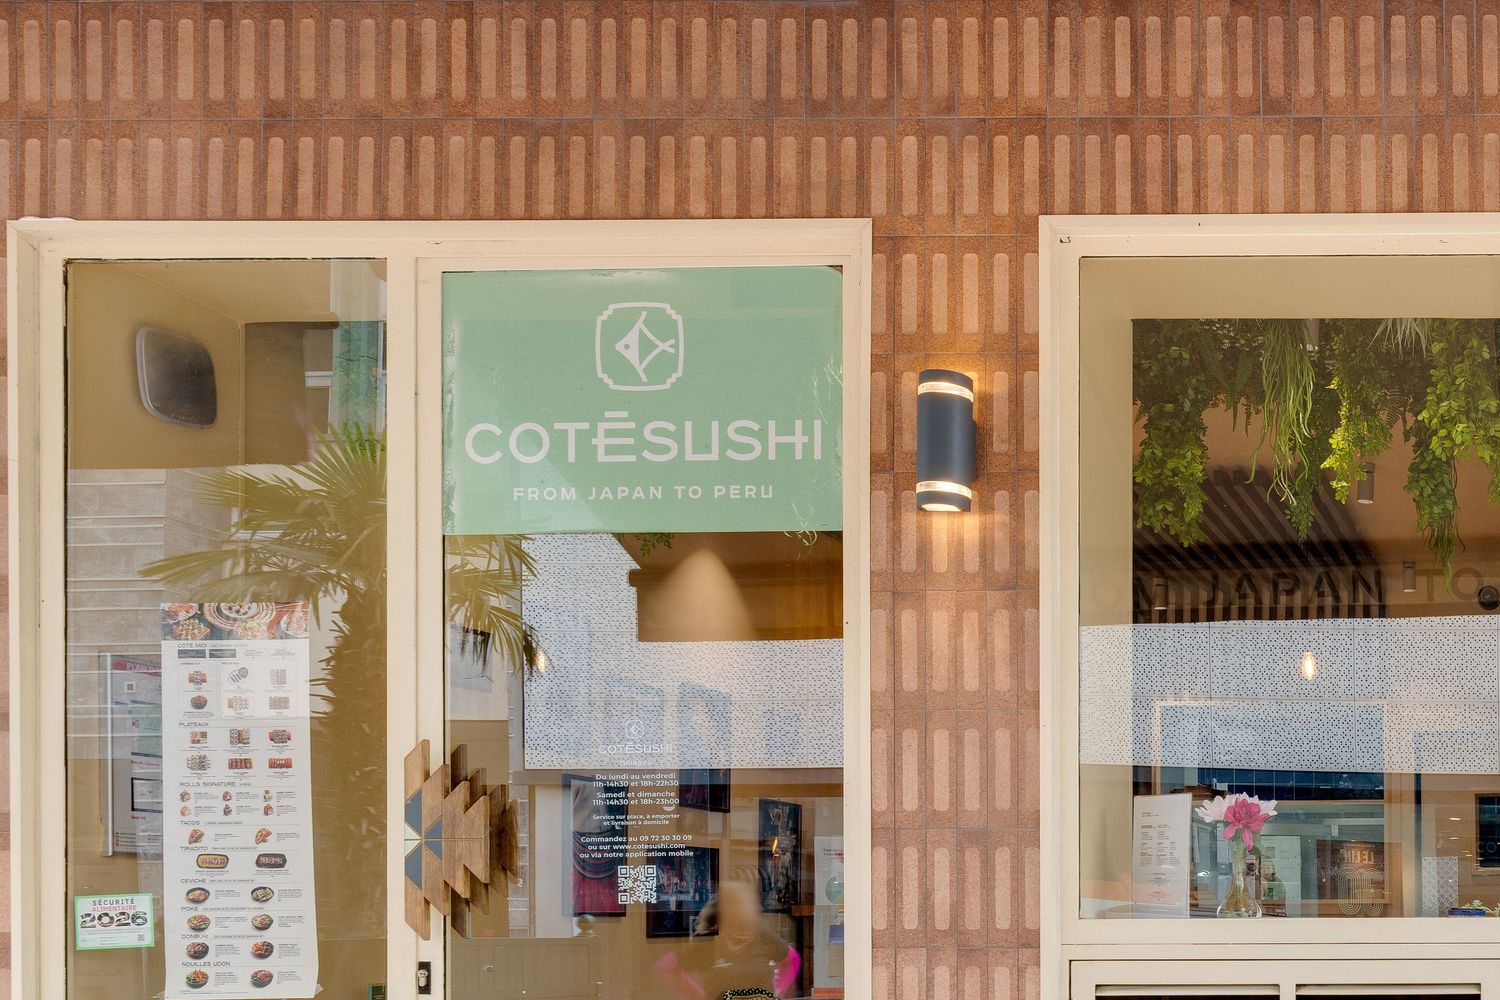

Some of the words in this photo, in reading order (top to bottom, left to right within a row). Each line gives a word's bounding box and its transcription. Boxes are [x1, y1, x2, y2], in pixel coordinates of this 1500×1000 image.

[513, 486, 576, 501] FROM
[588, 485, 663, 500] JAPAN
[673, 484, 703, 500] TO
[714, 484, 774, 499] PERU
[641, 772, 676, 780] vendredi
[636, 790, 676, 798] dimanche
[580, 835, 627, 843] Commandez
[612, 842, 686, 850] www.cotesushi.com
[625, 850, 667, 859] application
[668, 849, 694, 857] mobile
[92, 896, 136, 907] SÉCURITÉ
[91, 904, 137, 913] ALIMENTAIRE
[80, 910, 148, 929] 2026
